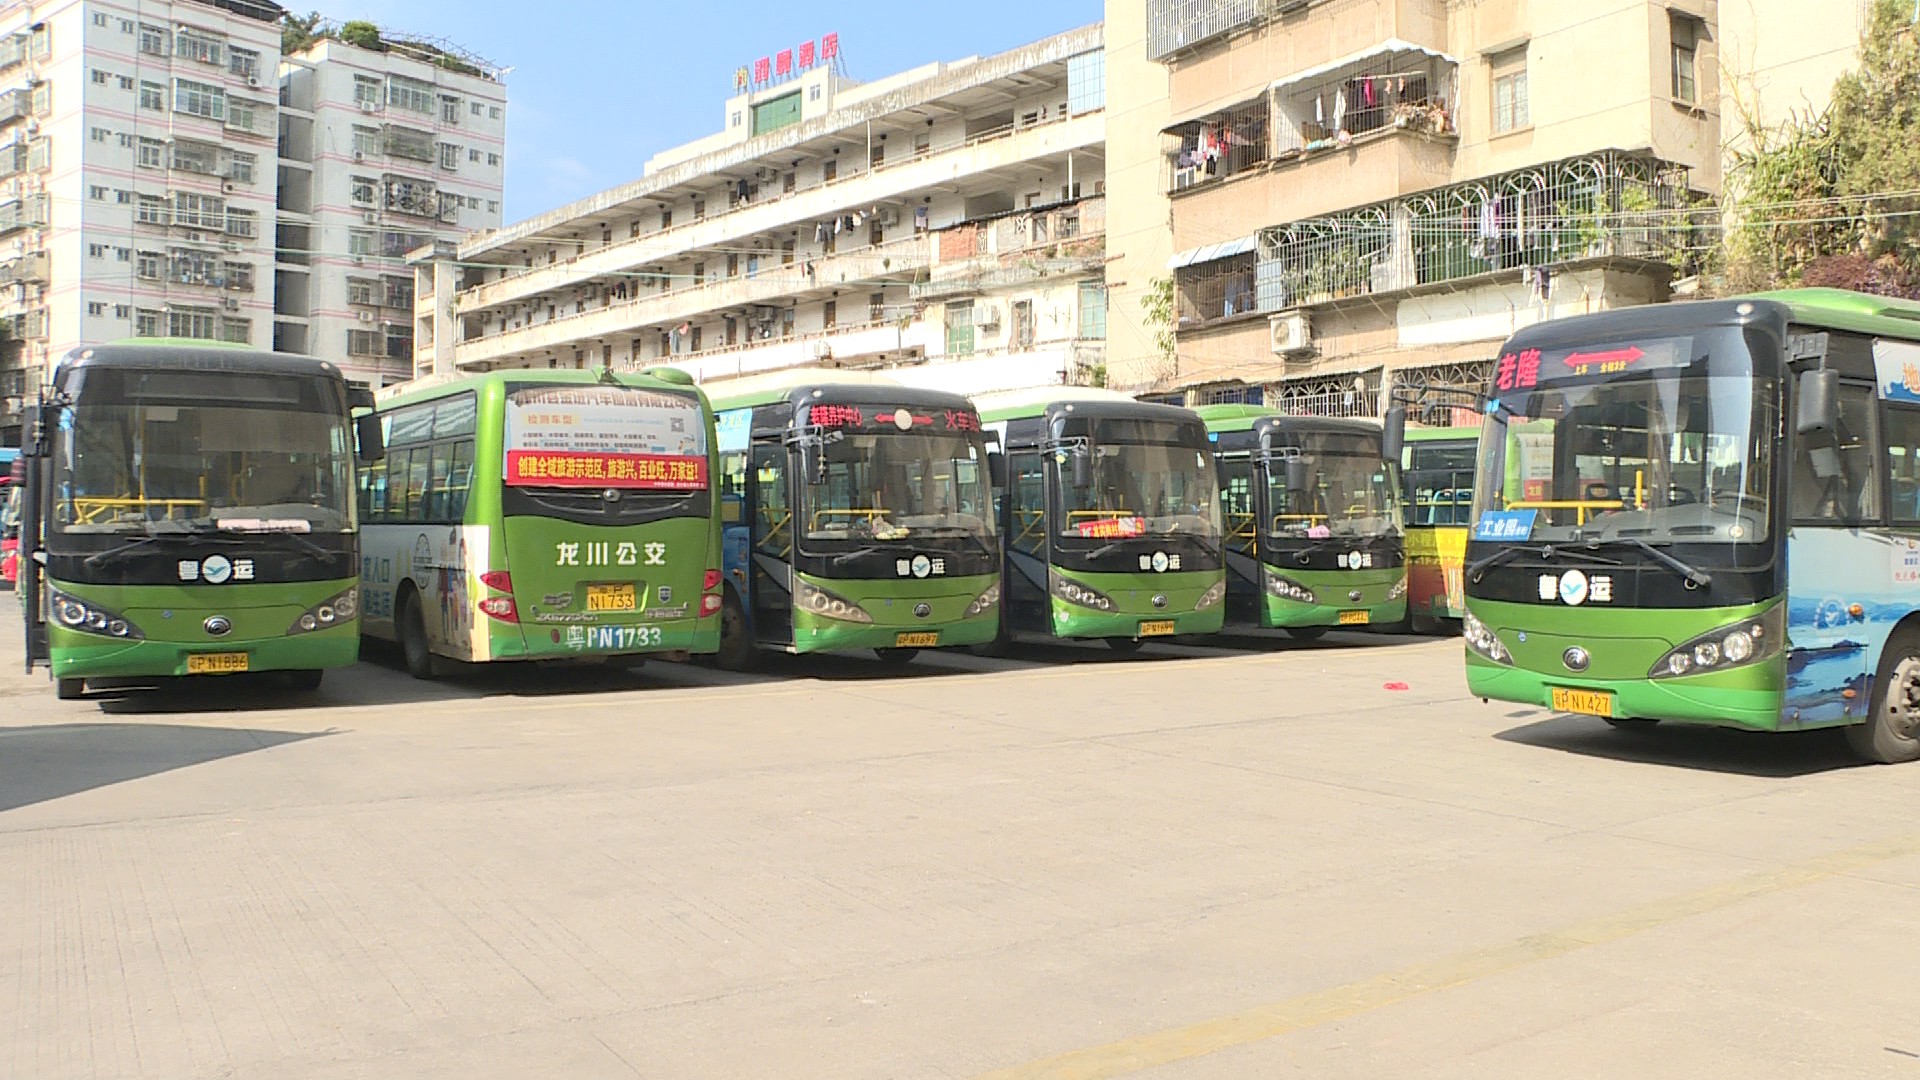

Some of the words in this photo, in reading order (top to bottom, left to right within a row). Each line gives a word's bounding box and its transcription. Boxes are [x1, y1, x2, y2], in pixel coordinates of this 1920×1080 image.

[1496, 349, 1541, 391] 老隆
[556, 542, 666, 566] 龙川公交
[589, 593, 633, 610] N1733
[565, 625, 662, 650] 粤PN1733
